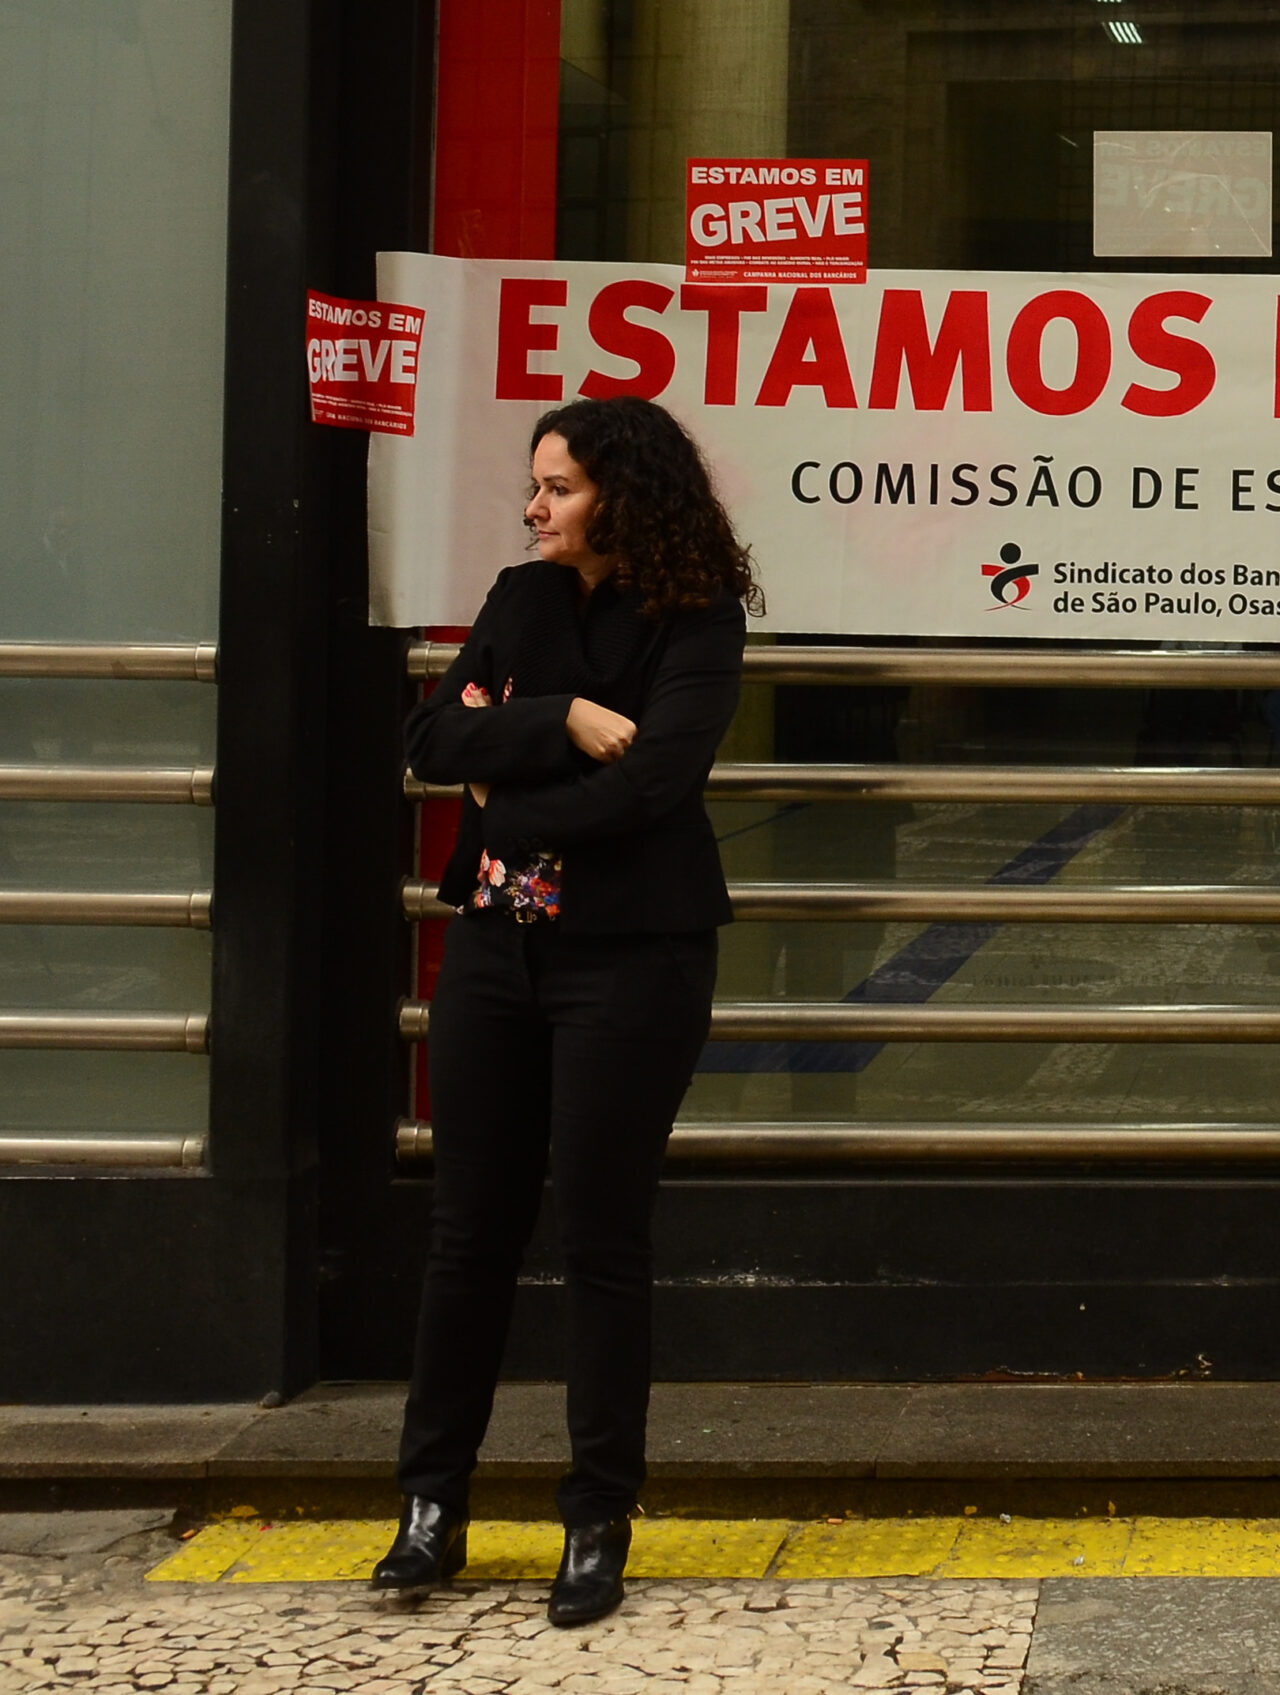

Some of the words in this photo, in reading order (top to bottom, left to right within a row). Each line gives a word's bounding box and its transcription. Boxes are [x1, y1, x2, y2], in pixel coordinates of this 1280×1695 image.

[691, 166, 817, 185] ESTAMOS
[825, 168, 864, 186] EM
[690, 192, 865, 247] GREVE
[308, 298, 382, 328] ESTAMOS
[388, 312, 421, 335] EM
[307, 338, 417, 384] GREVE
[496, 279, 1216, 417] ESTAMOS
[791, 455, 1102, 508] COMISSÃO
[1132, 467, 1200, 511] DE
[1053, 562, 1173, 585] Sindicato
[1180, 562, 1226, 585] dos
[1053, 591, 1085, 613] de
[1091, 591, 1137, 614] São
[1144, 592, 1222, 617] Paulo,
